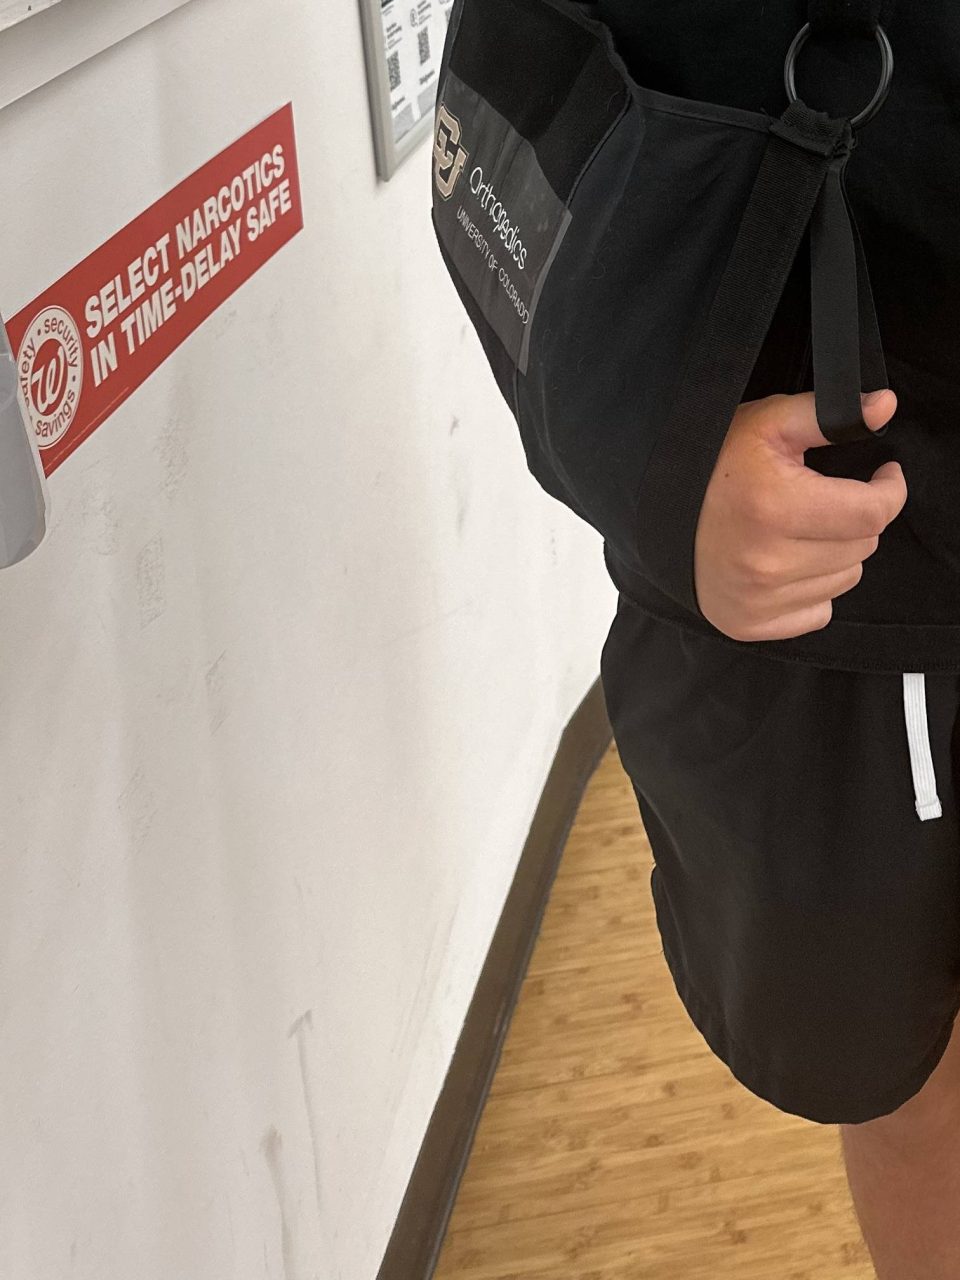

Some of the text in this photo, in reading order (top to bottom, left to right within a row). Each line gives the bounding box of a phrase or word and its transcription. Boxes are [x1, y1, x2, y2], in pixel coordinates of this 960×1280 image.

[85, 144, 285, 339] SELECT NARCOTICS
[456, 205, 530, 325] UNIVERSITY OF COLORADO
[469, 166, 528, 270] Orthopedics
[90, 178, 292, 388] IN TIME-DELAY SAFE
[44, 316, 78, 368] security
[35, 390, 76, 438] savings
